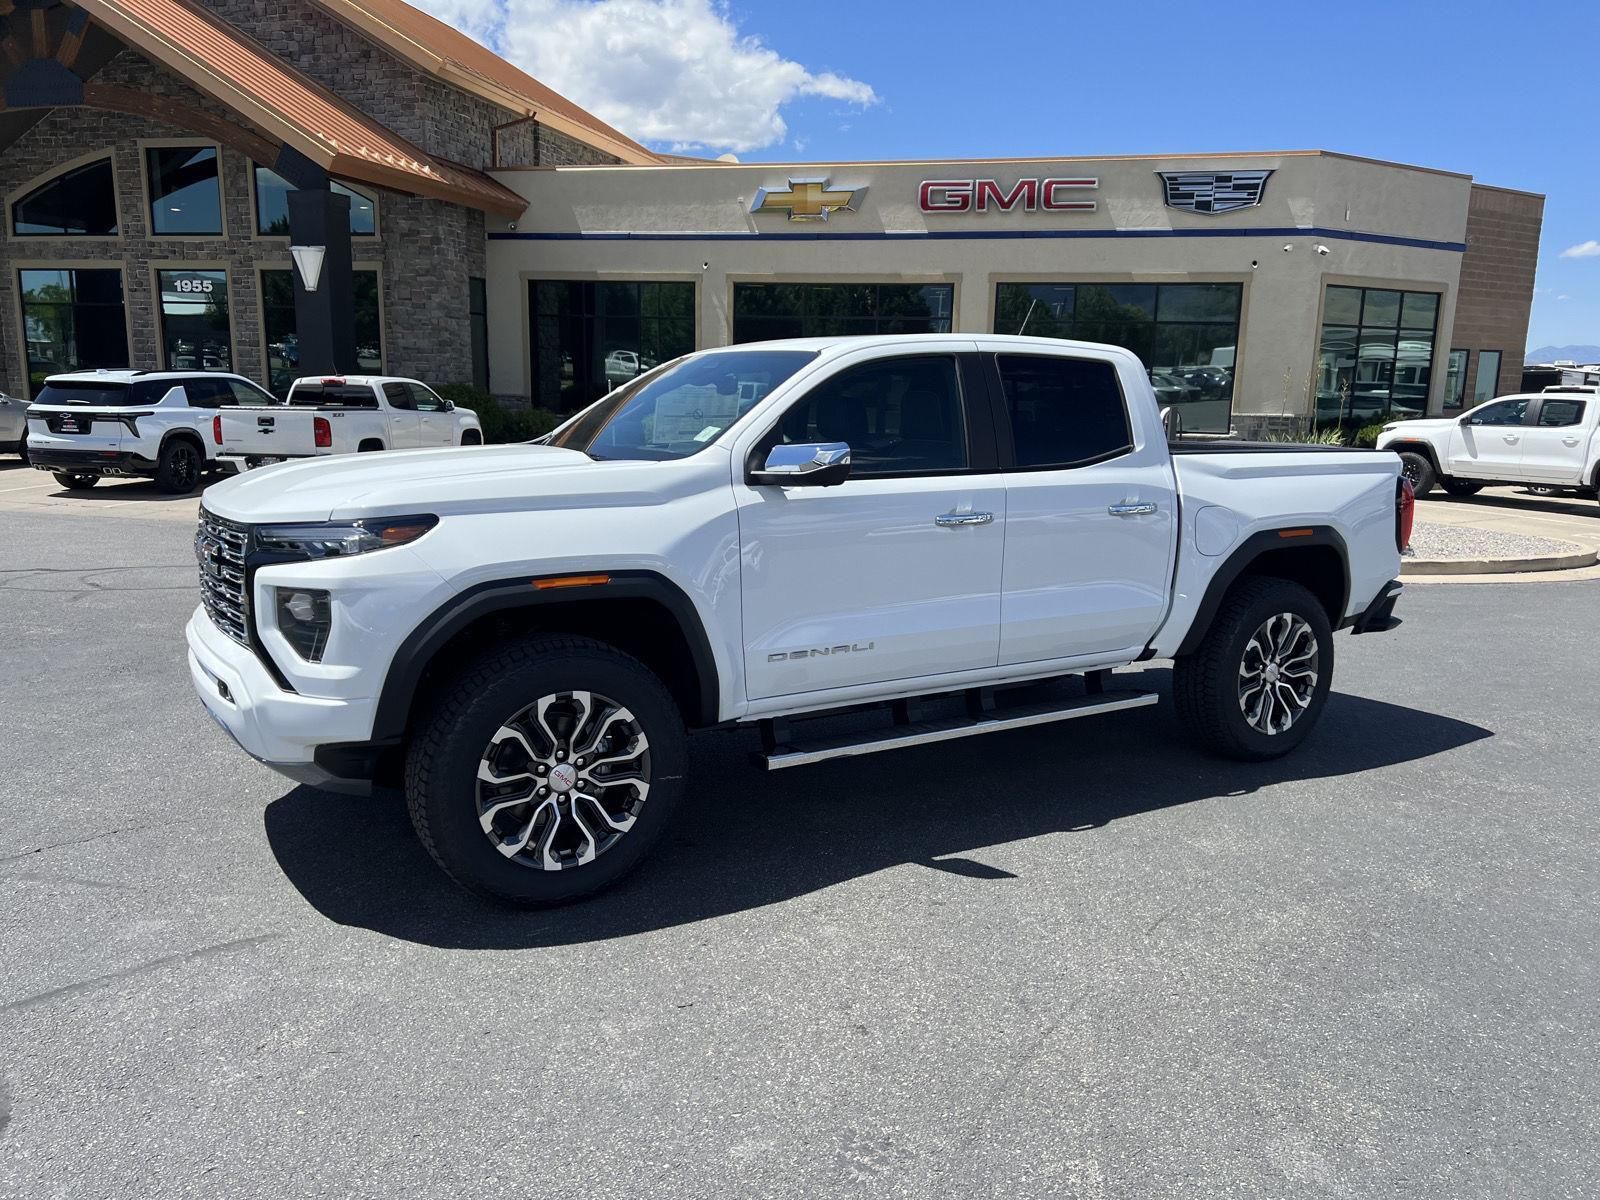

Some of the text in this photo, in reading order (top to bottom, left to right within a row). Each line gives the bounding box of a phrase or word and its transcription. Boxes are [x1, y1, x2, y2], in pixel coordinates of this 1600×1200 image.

[918, 178, 1099, 213] GMC
[173, 279, 213, 292] 1955
[767, 641, 875, 663] DENALI
[554, 769, 573, 787] GMC
